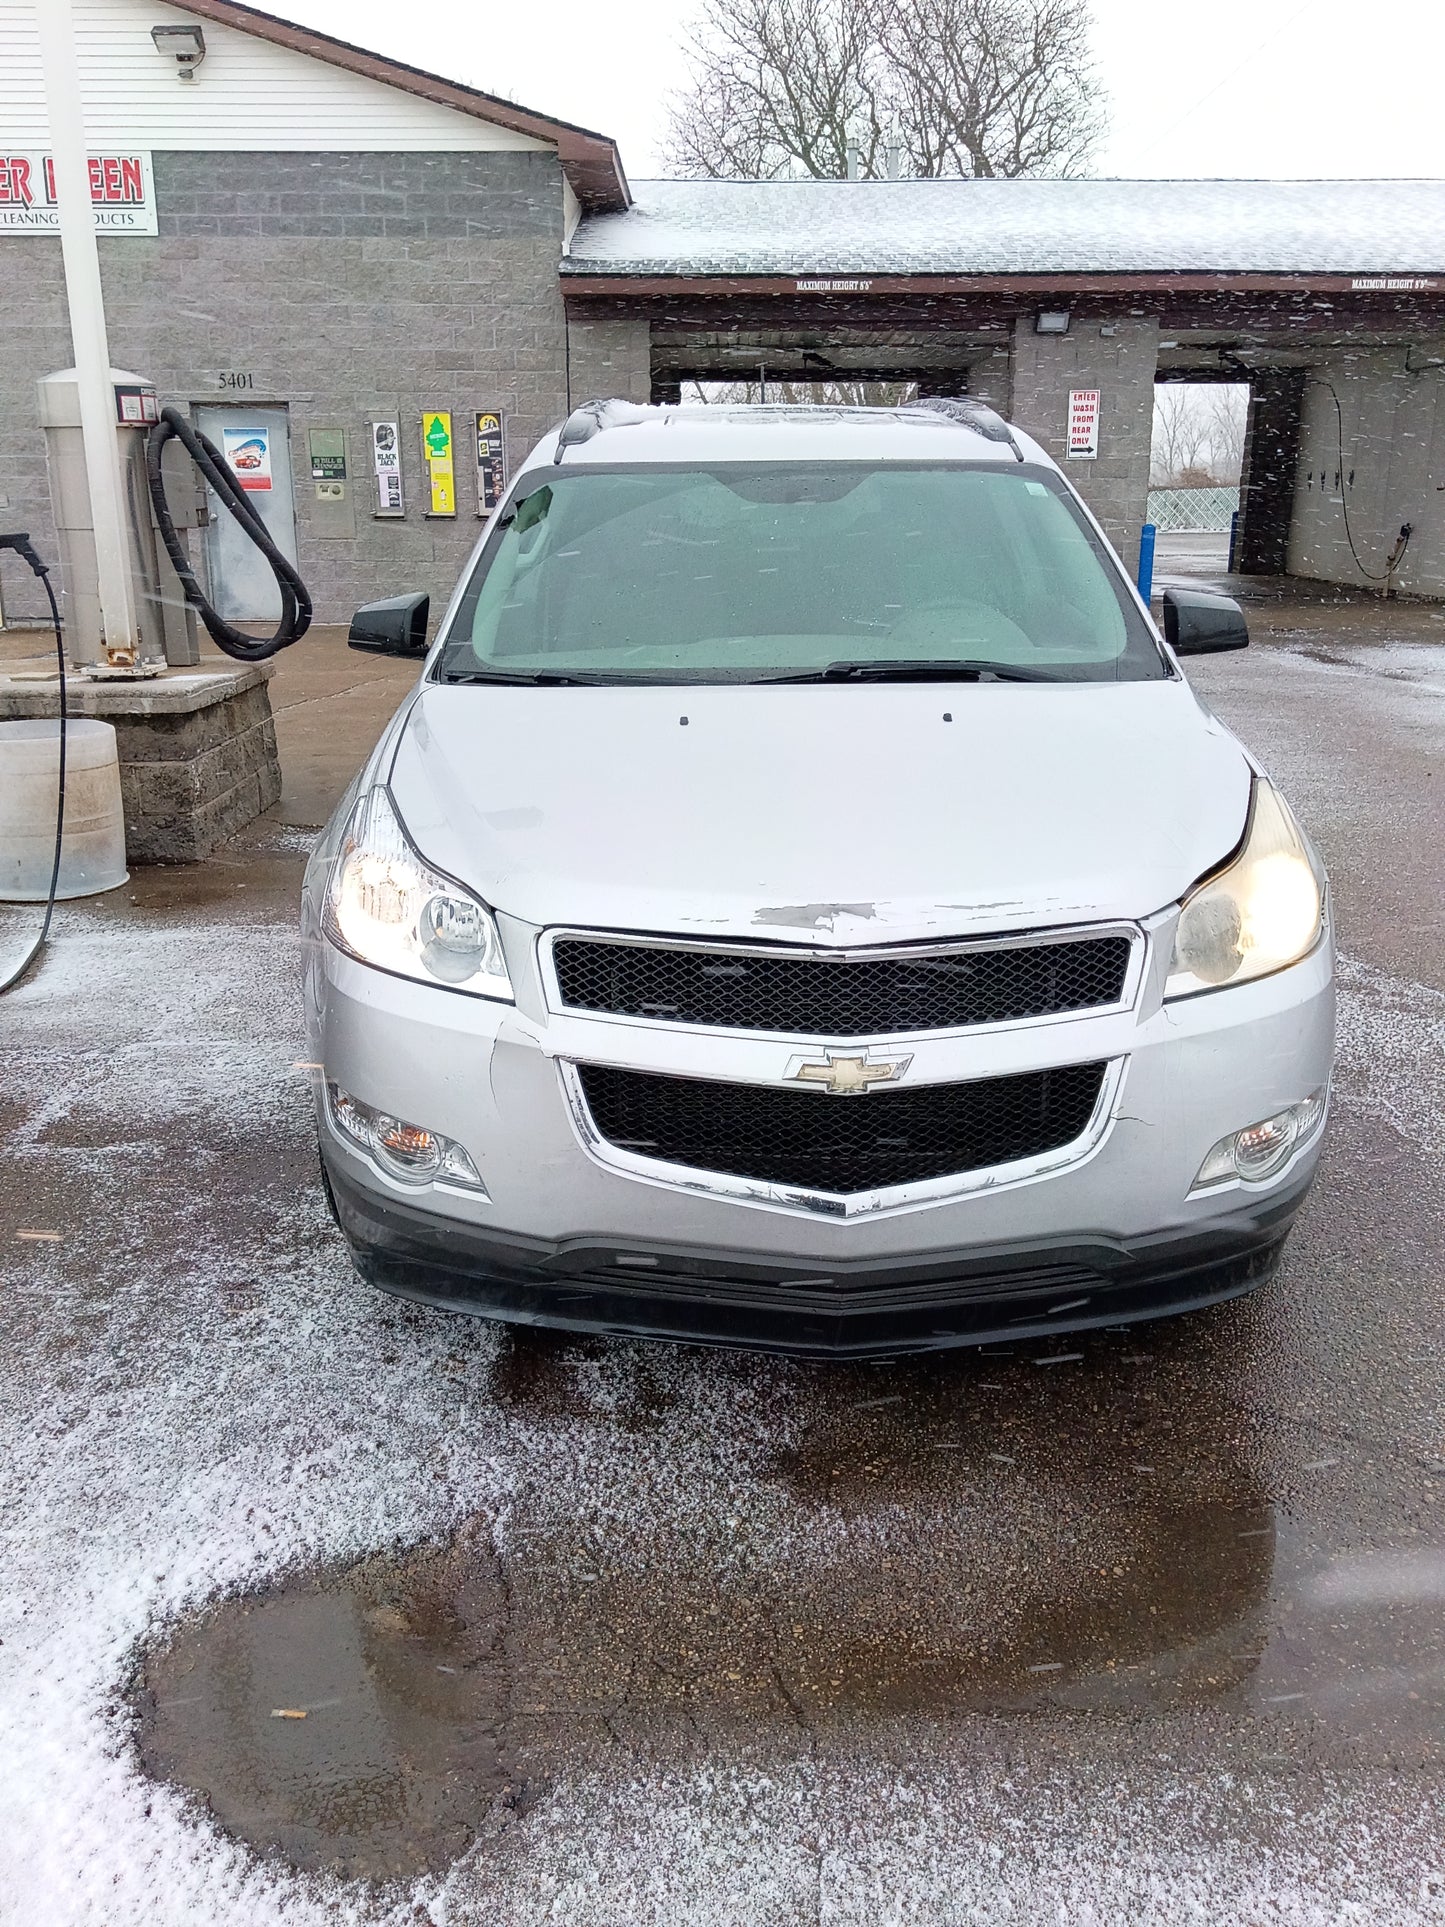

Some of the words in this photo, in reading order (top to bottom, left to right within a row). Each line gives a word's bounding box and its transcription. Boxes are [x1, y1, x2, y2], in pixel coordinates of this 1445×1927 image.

[796, 280, 831, 291] MAXIMUM
[831, 280, 859, 291] HEIGHT
[1351, 279, 1386, 290] MAXIMUM
[1386, 279, 1414, 290] HEIGHT
[218, 372, 254, 390] 5401
[1073, 393, 1096, 402] ENTER
[1073, 404, 1095, 412] WASH
[1072, 415, 1094, 423] FROM
[1071, 426, 1091, 434] REAR
[1071, 437, 1090, 445] ONLY
